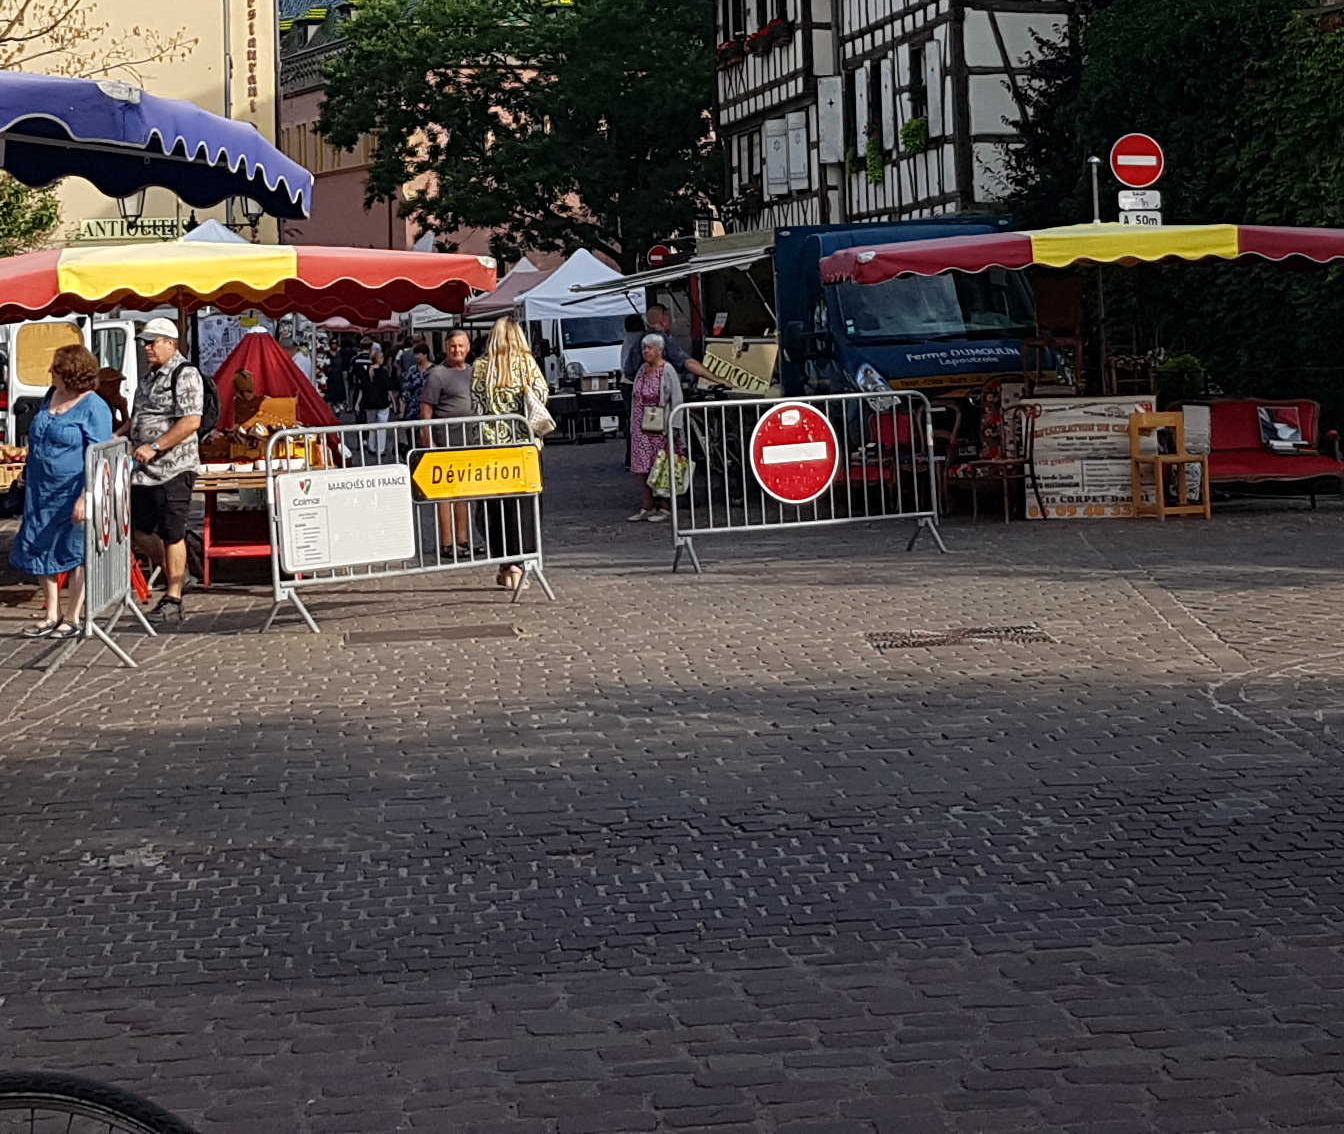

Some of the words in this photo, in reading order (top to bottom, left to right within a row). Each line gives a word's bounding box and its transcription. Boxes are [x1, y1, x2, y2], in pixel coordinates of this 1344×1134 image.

[1123, 215, 1130, 225] A
[1135, 215, 1158, 225] 50m
[906, 350, 948, 362] Ferme
[950, 347, 1021, 357] DUMOULIN
[431, 461, 521, 484] Déviation
[328, 478, 364, 491] MARCHÉS
[366, 479, 376, 488] DE
[377, 476, 407, 487] FRANCE
[293, 497, 321, 507] Colmar
